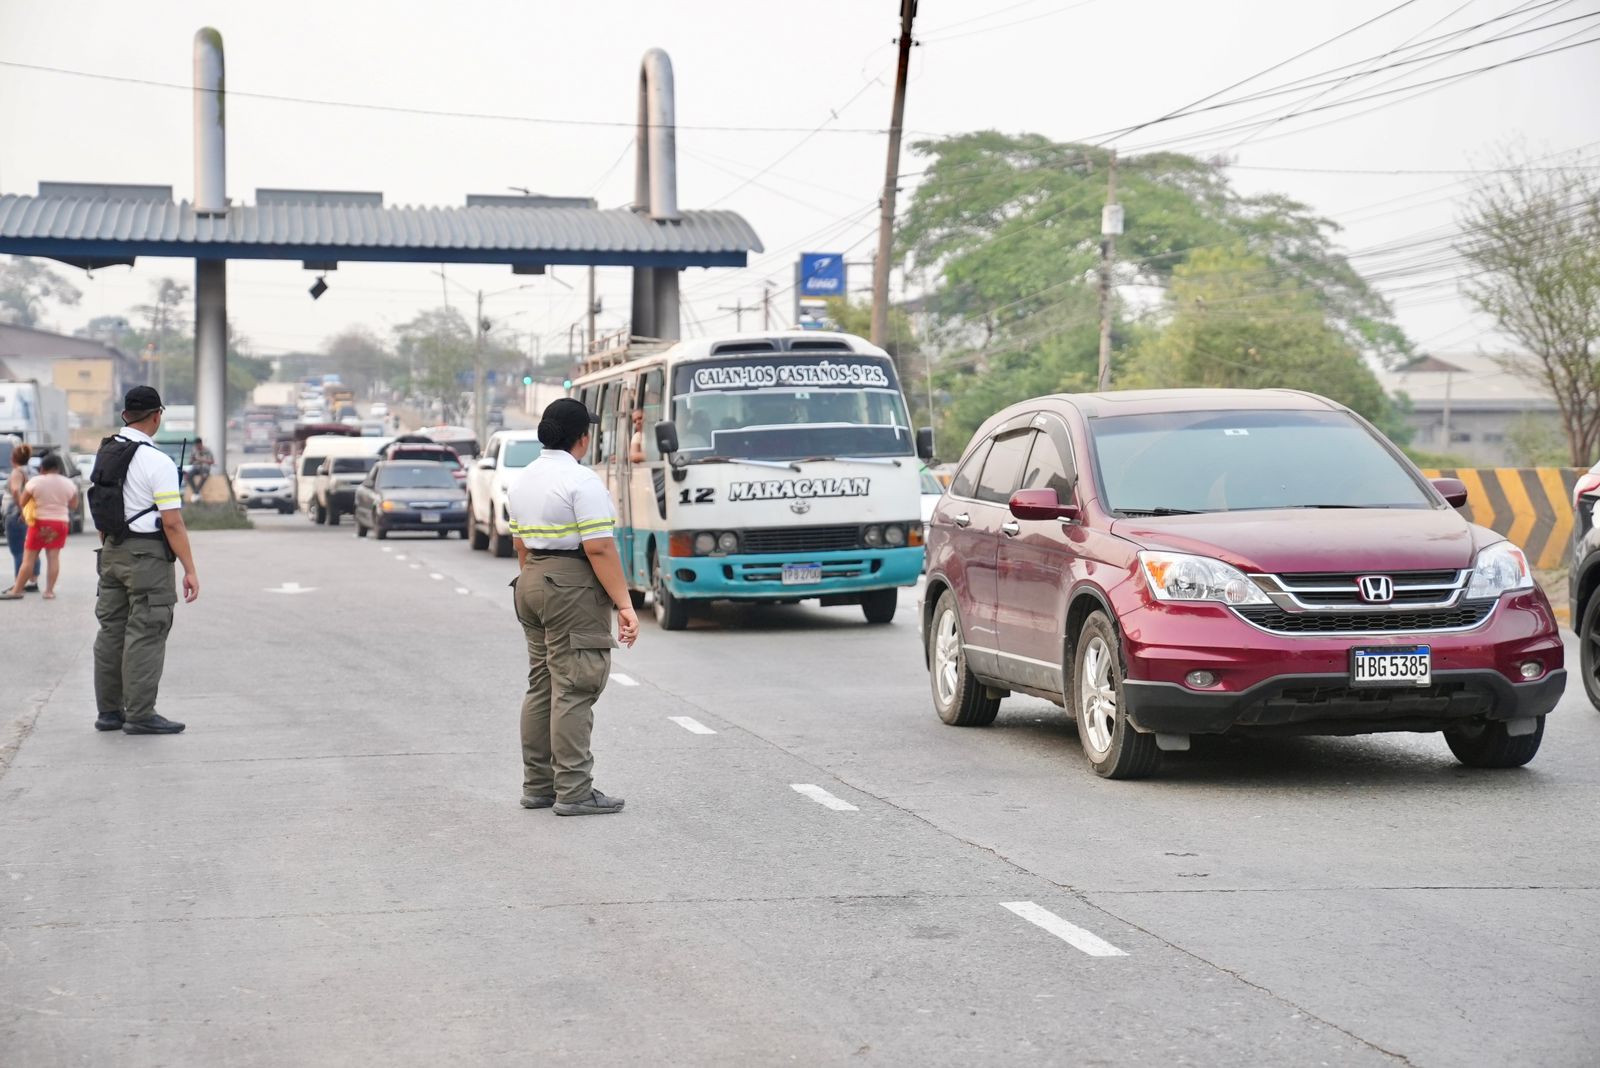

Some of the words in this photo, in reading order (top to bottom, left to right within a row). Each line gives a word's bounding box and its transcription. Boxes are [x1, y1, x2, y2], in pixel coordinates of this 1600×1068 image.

[679, 488, 714, 504] 12
[728, 477, 871, 501] MARACALAN
[1356, 655, 1428, 678] HBG5385
